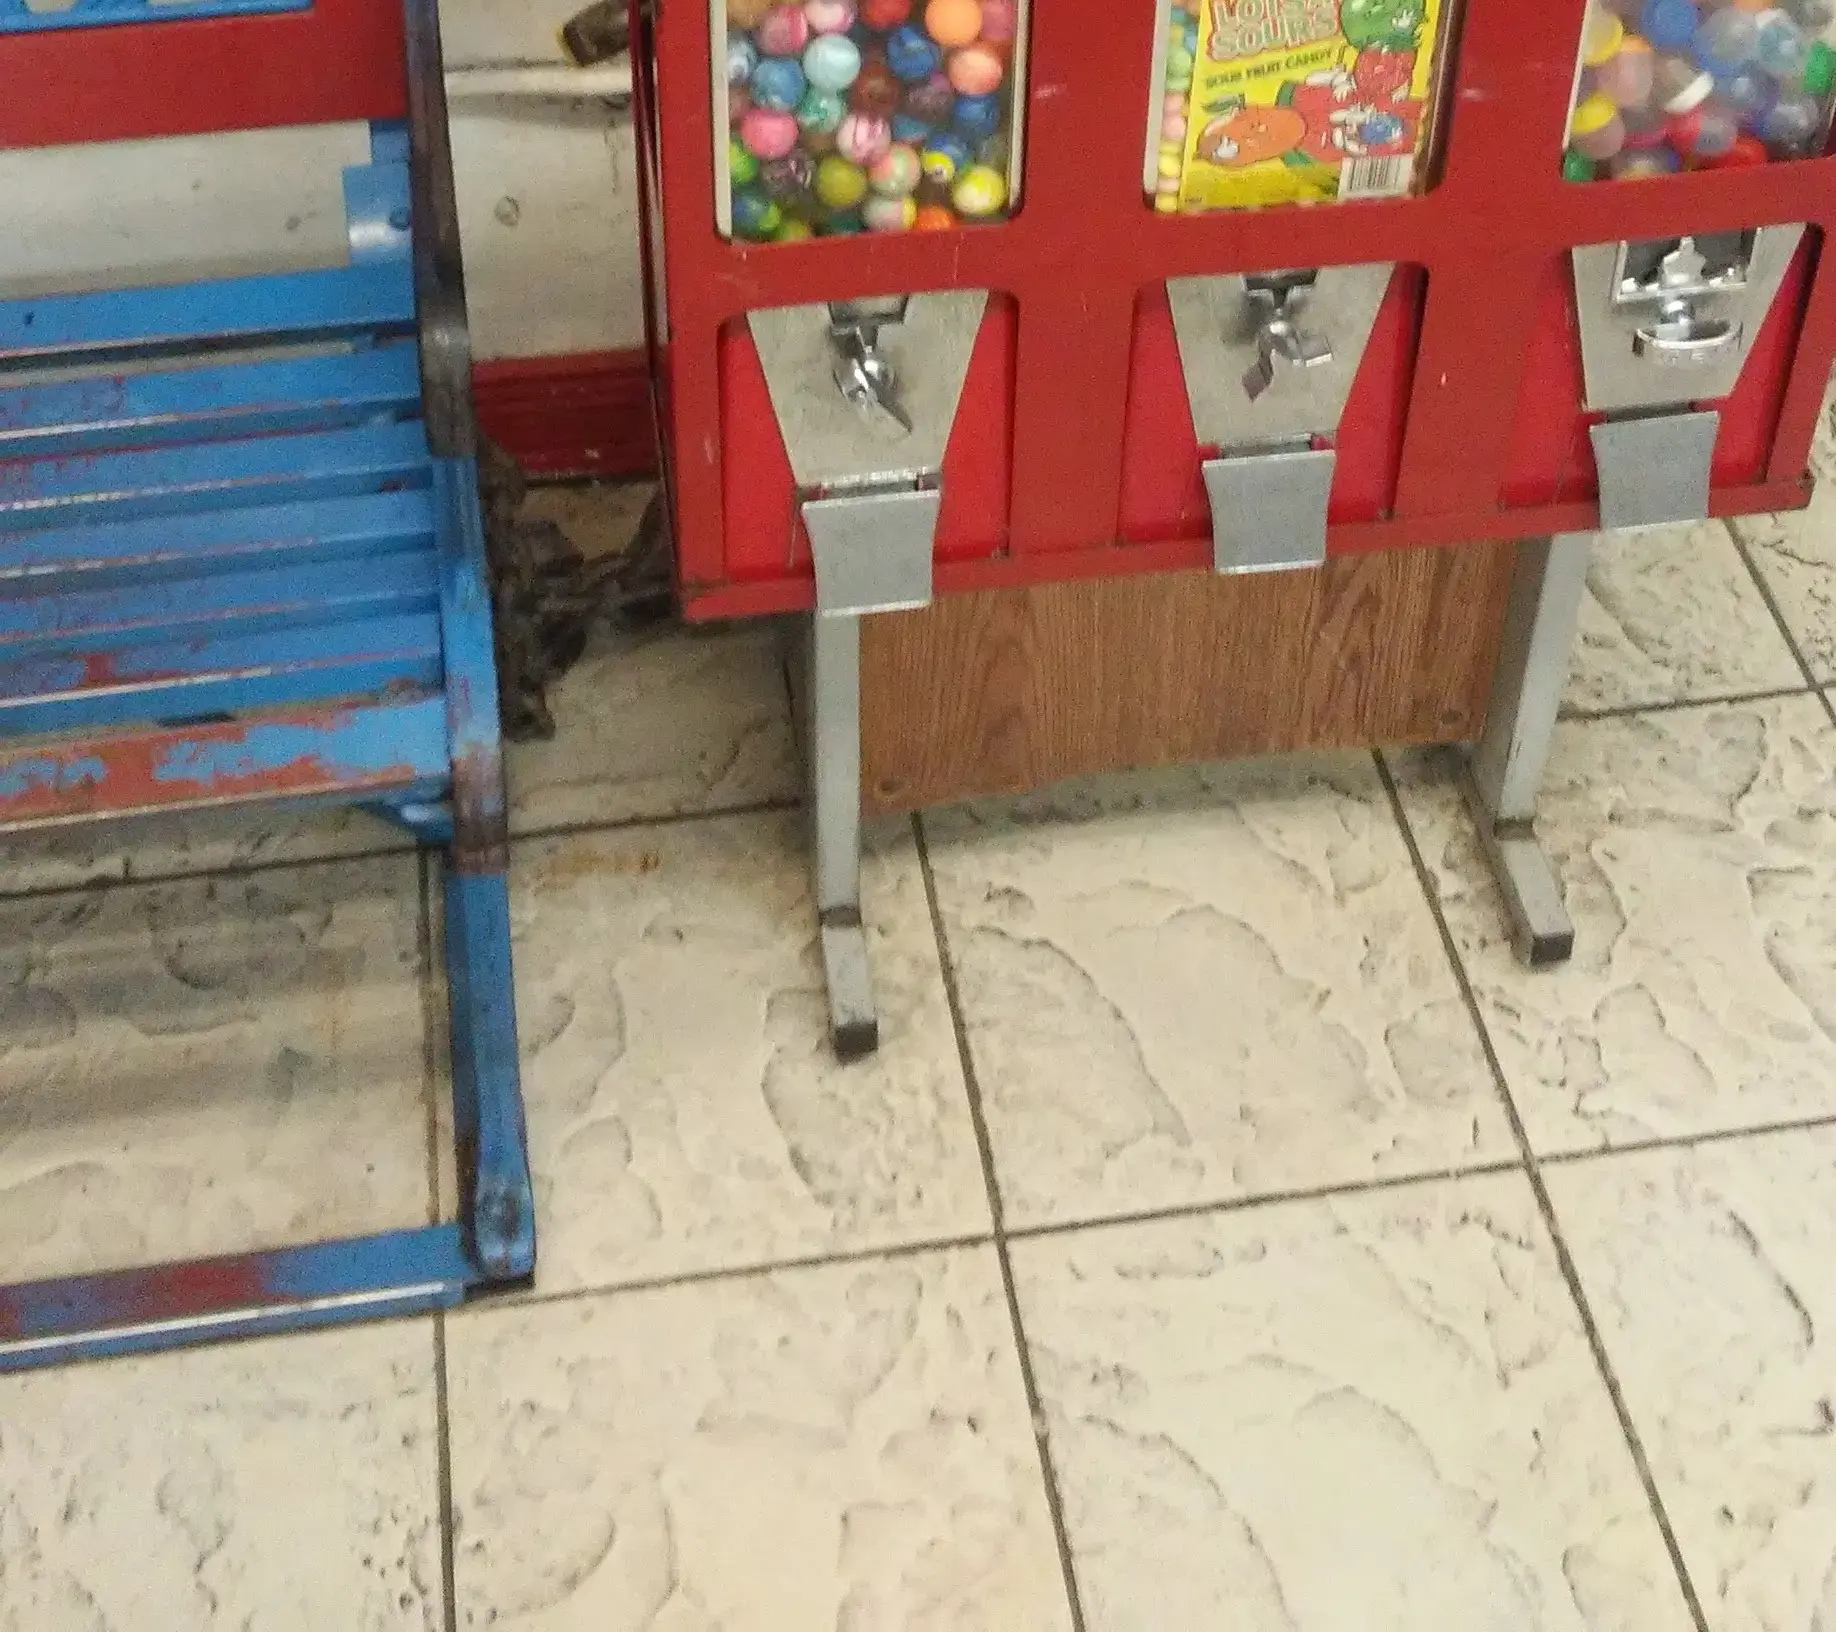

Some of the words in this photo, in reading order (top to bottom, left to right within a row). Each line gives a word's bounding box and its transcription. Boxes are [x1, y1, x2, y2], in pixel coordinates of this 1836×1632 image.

[1207, 6, 1340, 61] SOURS
[1246, 61, 1281, 80] FRUIT
[1285, 48, 1332, 67] CANDY
